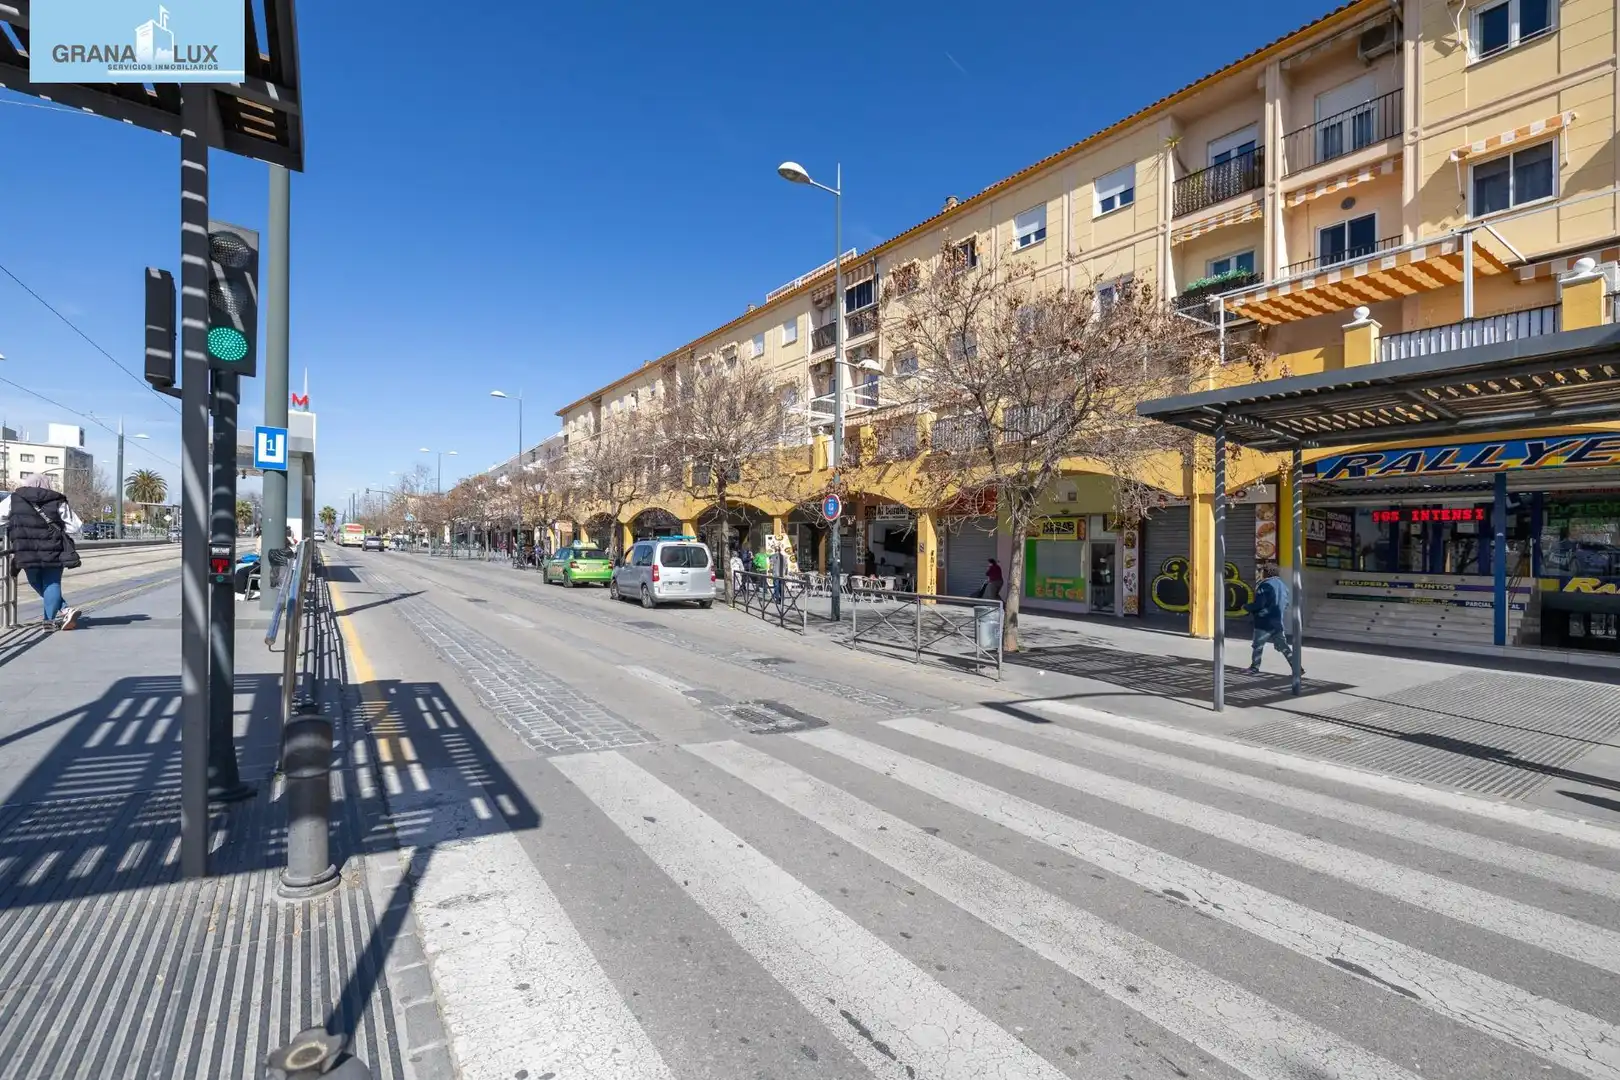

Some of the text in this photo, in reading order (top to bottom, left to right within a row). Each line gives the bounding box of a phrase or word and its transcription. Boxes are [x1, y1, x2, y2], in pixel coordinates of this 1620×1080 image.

[292, 392, 309, 407] M
[1320, 435, 1620, 480] RALLYE
[1338, 580, 1389, 588] RECUPERA
[1414, 583, 1455, 591] PUNTOS
